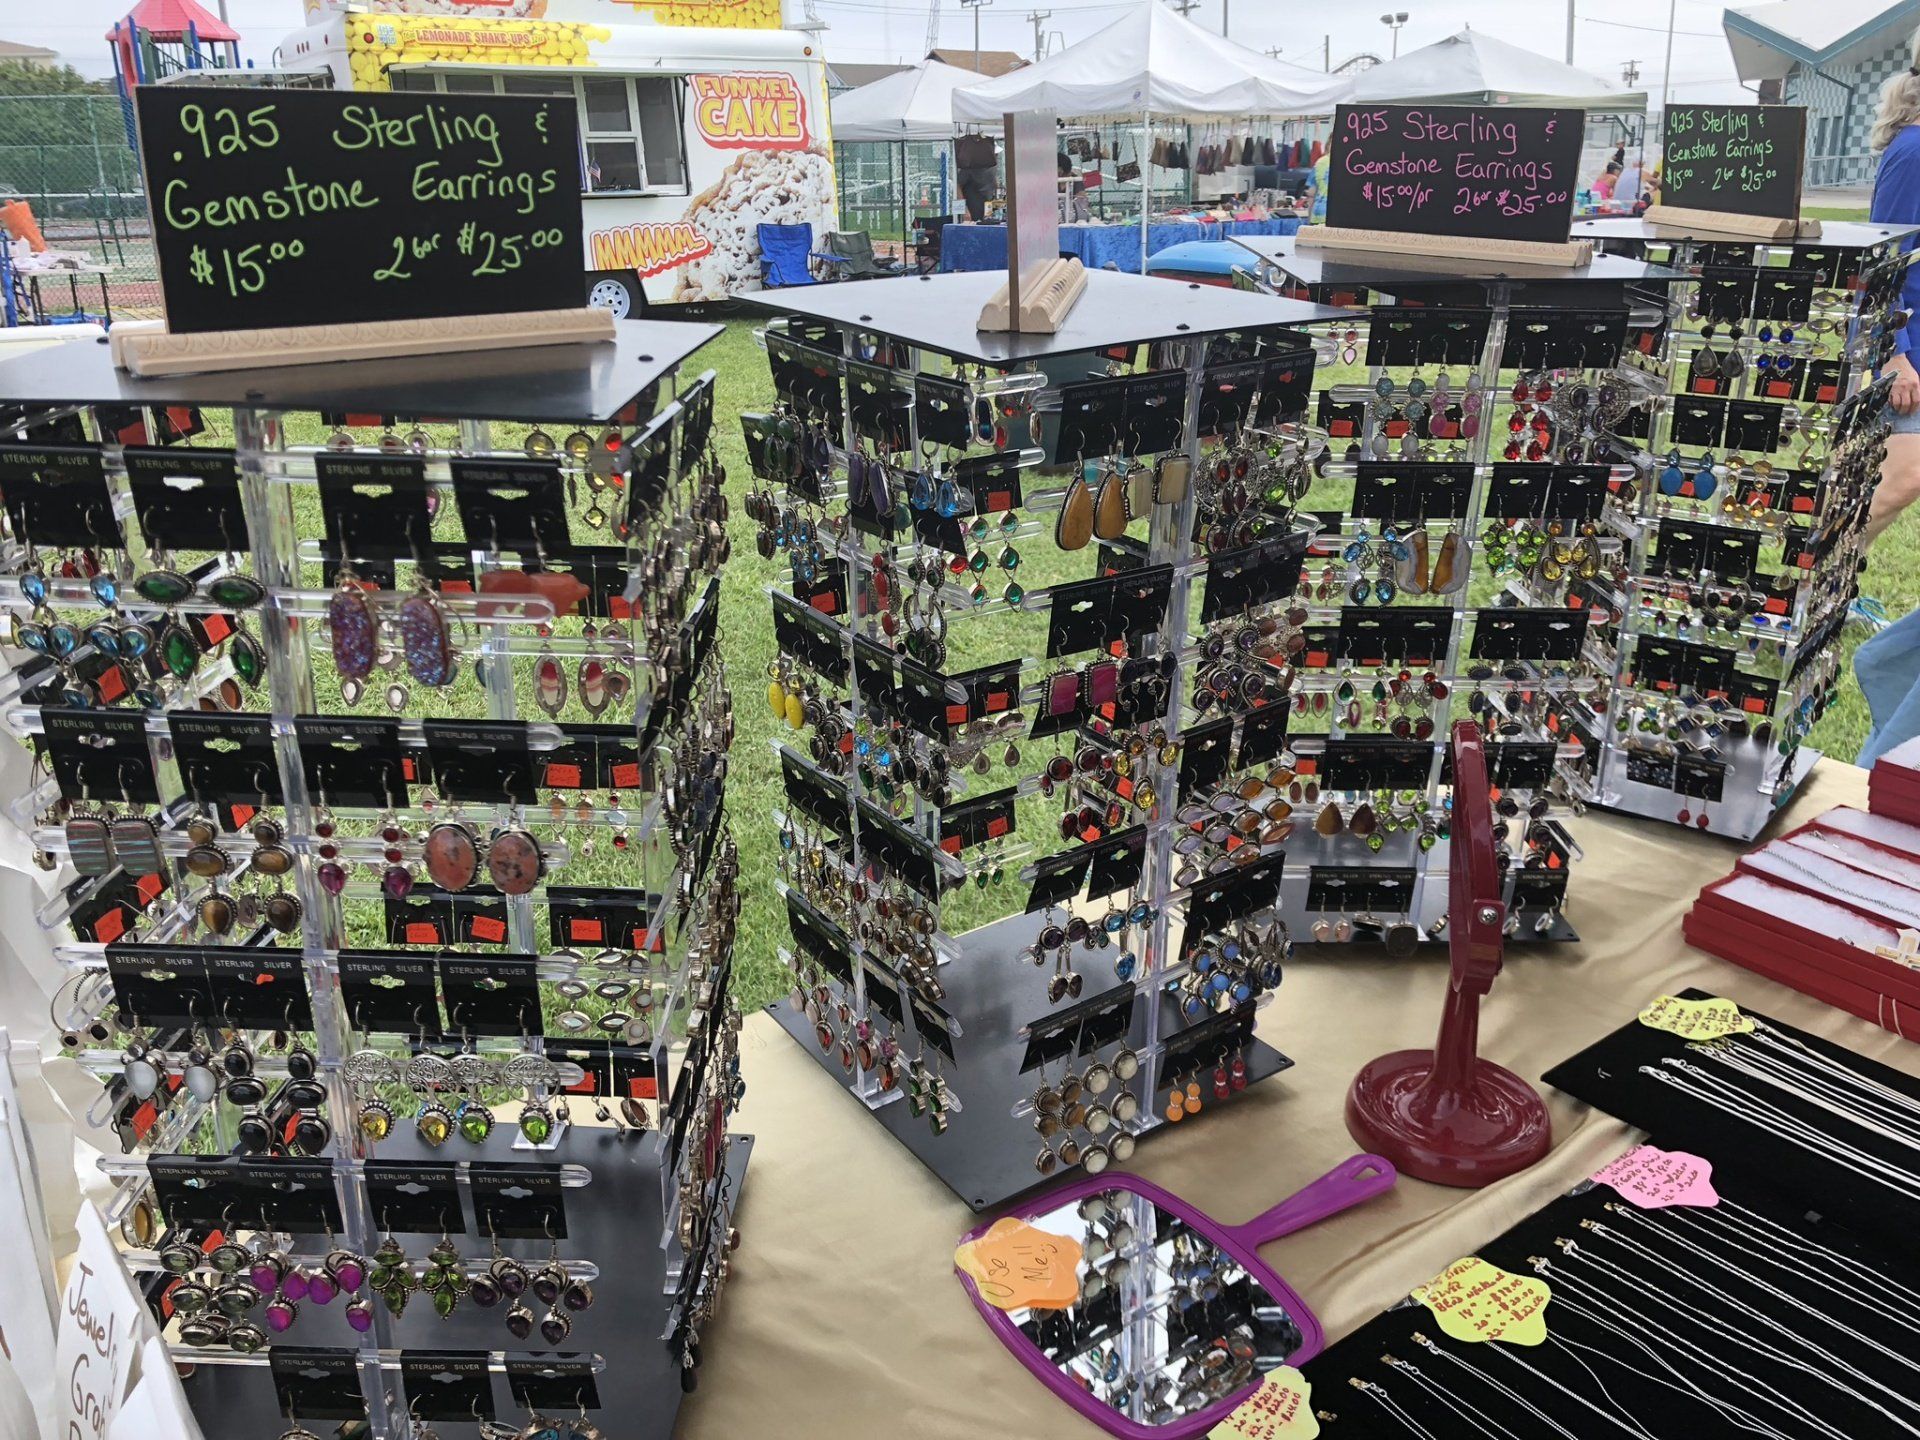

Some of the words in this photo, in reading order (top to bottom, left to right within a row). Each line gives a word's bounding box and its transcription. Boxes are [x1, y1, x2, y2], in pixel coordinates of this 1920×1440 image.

[415, 29, 473, 44] LEMONADE
[474, 31, 531, 46] SHAKE-UPS
[694, 75, 797, 100] FUNNEL
[698, 97, 801, 138] CAKE
[1667, 109, 1695, 136] .925
[1701, 108, 1749, 142] Sterling
[173, 104, 281, 162] .925
[332, 105, 503, 168] Sterling
[1342, 110, 1388, 143] .925
[1402, 111, 1517, 156] Sterling
[1667, 137, 1719, 163] Gemstone
[1725, 138, 1774, 168] Earrings
[1345, 148, 1442, 176] Gemstone
[1455, 152, 1553, 191] Earrings
[1665, 166, 1694, 192] $15.00
[1740, 165, 1777, 192] $25.00
[163, 166, 379, 230] Gemstone
[412, 160, 558, 214] Earrings
[1495, 189, 1567, 216] $25.00
[189, 239, 305, 297] $15.00
[456, 221, 563, 277] $25.00
[2, 454, 48, 465] STERLING
[56, 455, 90, 466] SILVER
[134, 458, 182, 470] STERLING
[190, 460, 223, 471] SILVER
[325, 464, 371, 475] STERLING
[380, 465, 413, 476] SILVER
[51, 719, 95, 730] STERLING
[104, 721, 135, 732] SILVER
[178, 723, 222, 734] STERLING
[230, 725, 261, 736] SILVER
[303, 725, 347, 736] STERLING
[355, 725, 388, 736] SILVER
[433, 730, 478, 741] STERLING
[482, 731, 515, 742] SILVER
[115, 956, 156, 966] STERLING
[164, 957, 194, 967] SILVER
[214, 959, 255, 969] STERLING
[263, 960, 293, 970] SILVER
[346, 963, 387, 973] STERLING
[395, 964, 425, 974] SILVER
[448, 966, 489, 976] STERLING
[498, 967, 528, 977] SILVER
[156, 1166, 197, 1176] STERLING
[200, 1167, 230, 1177] SILVER
[249, 1170, 288, 1180] STERLING
[295, 1171, 324, 1180] SILVER
[373, 1173, 412, 1182] STERLING
[420, 1174, 448, 1183] SILVER
[477, 1176, 516, 1186] STERLING
[523, 1177, 552, 1186] SILVER
[277, 1358, 316, 1368] STERLING
[320, 1359, 347, 1368] SILVER
[409, 1362, 447, 1372] STERLING
[453, 1363, 481, 1372] SILVER
[511, 1362, 549, 1371] STERLING
[555, 1362, 582, 1371] SILVER
